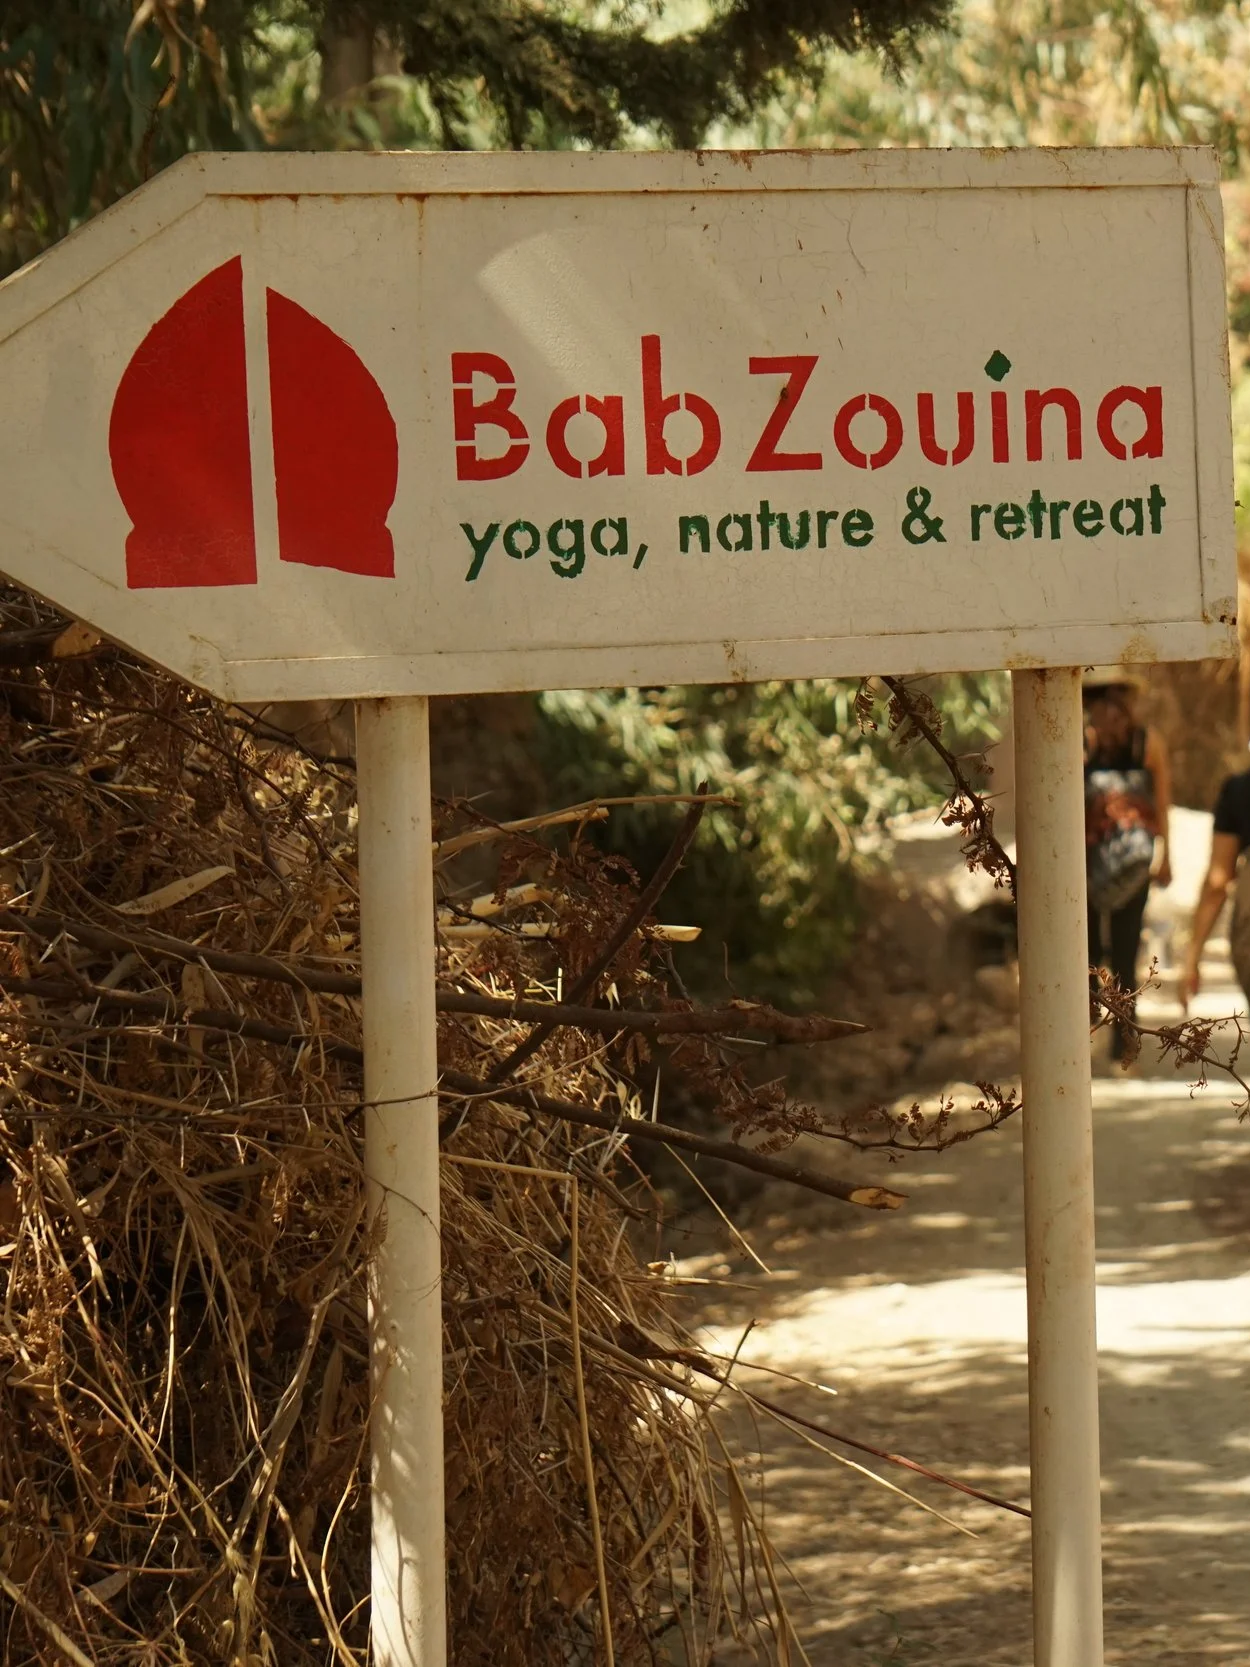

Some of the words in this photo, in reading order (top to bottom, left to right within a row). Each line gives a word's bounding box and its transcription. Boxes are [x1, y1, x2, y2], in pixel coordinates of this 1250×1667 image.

[460, 515, 649, 582] yoga,
[679, 499, 875, 554] nature
[901, 486, 947, 545] &
[970, 484, 1167, 543] retreat
